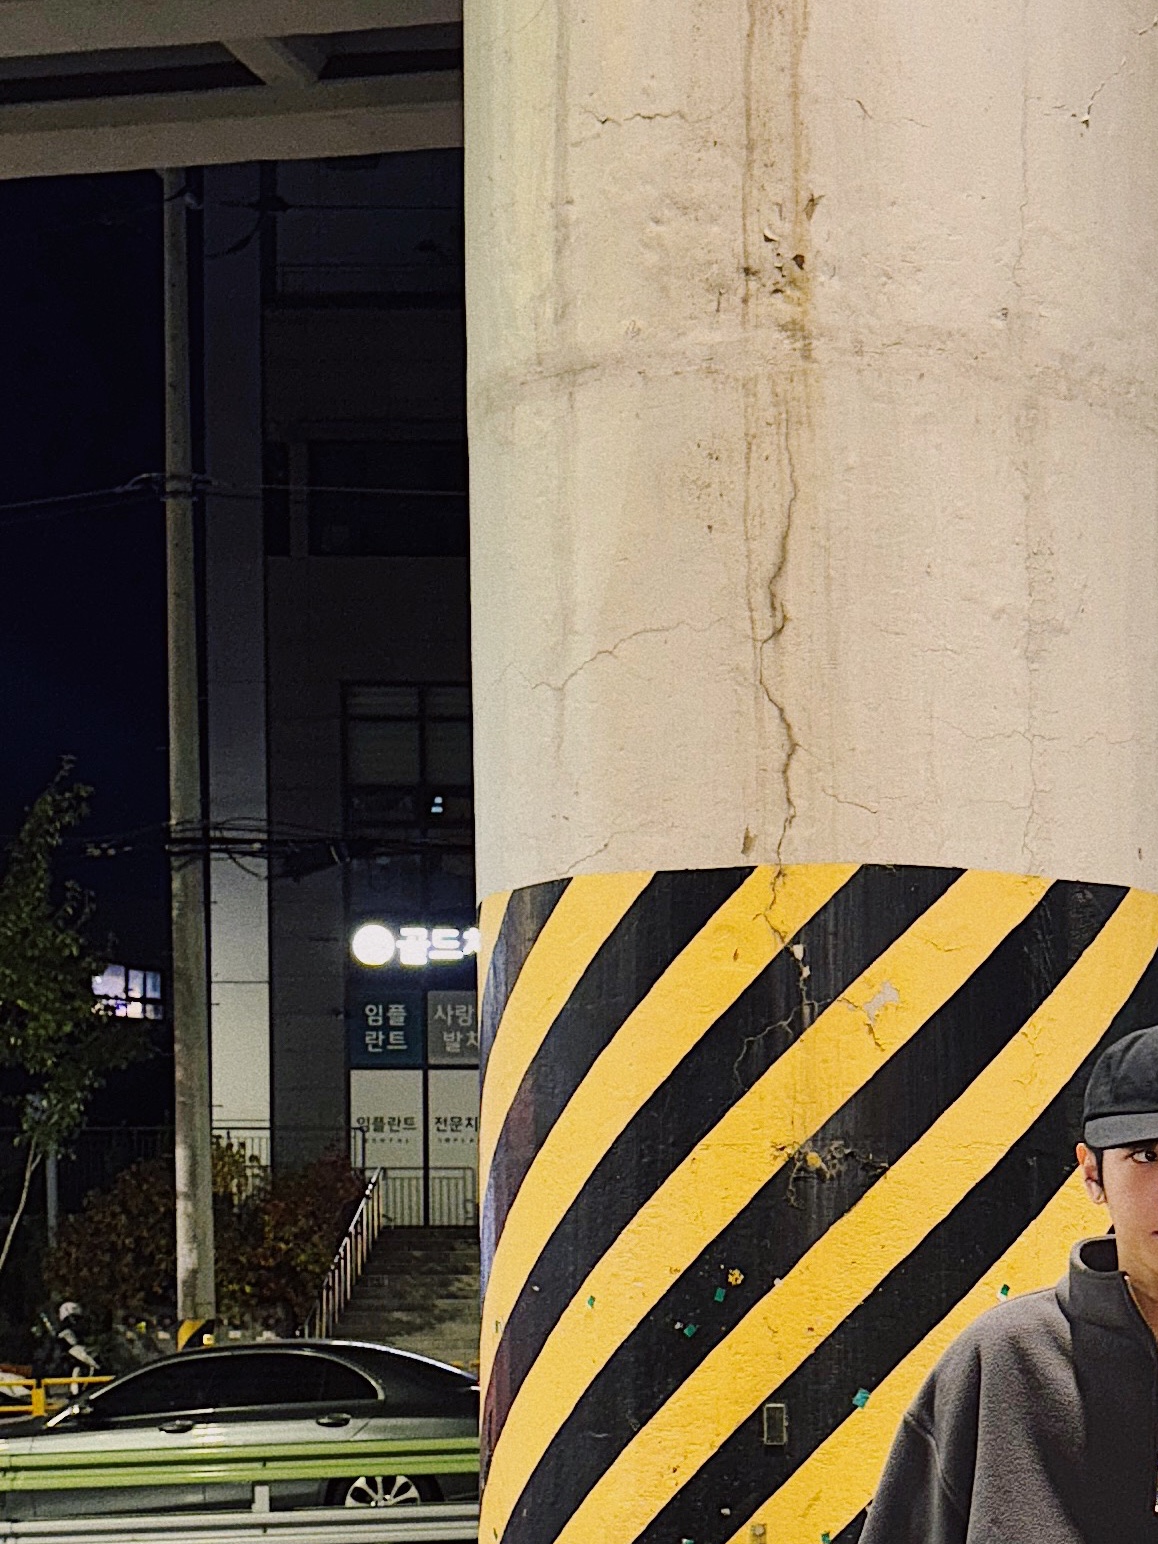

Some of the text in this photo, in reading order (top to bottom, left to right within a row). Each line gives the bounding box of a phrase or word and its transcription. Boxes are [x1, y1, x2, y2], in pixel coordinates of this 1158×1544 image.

[364, 1003, 408, 1027] 임플
[364, 1030, 408, 1053] 란트
[356, 1116, 418, 1134] 임플란트
